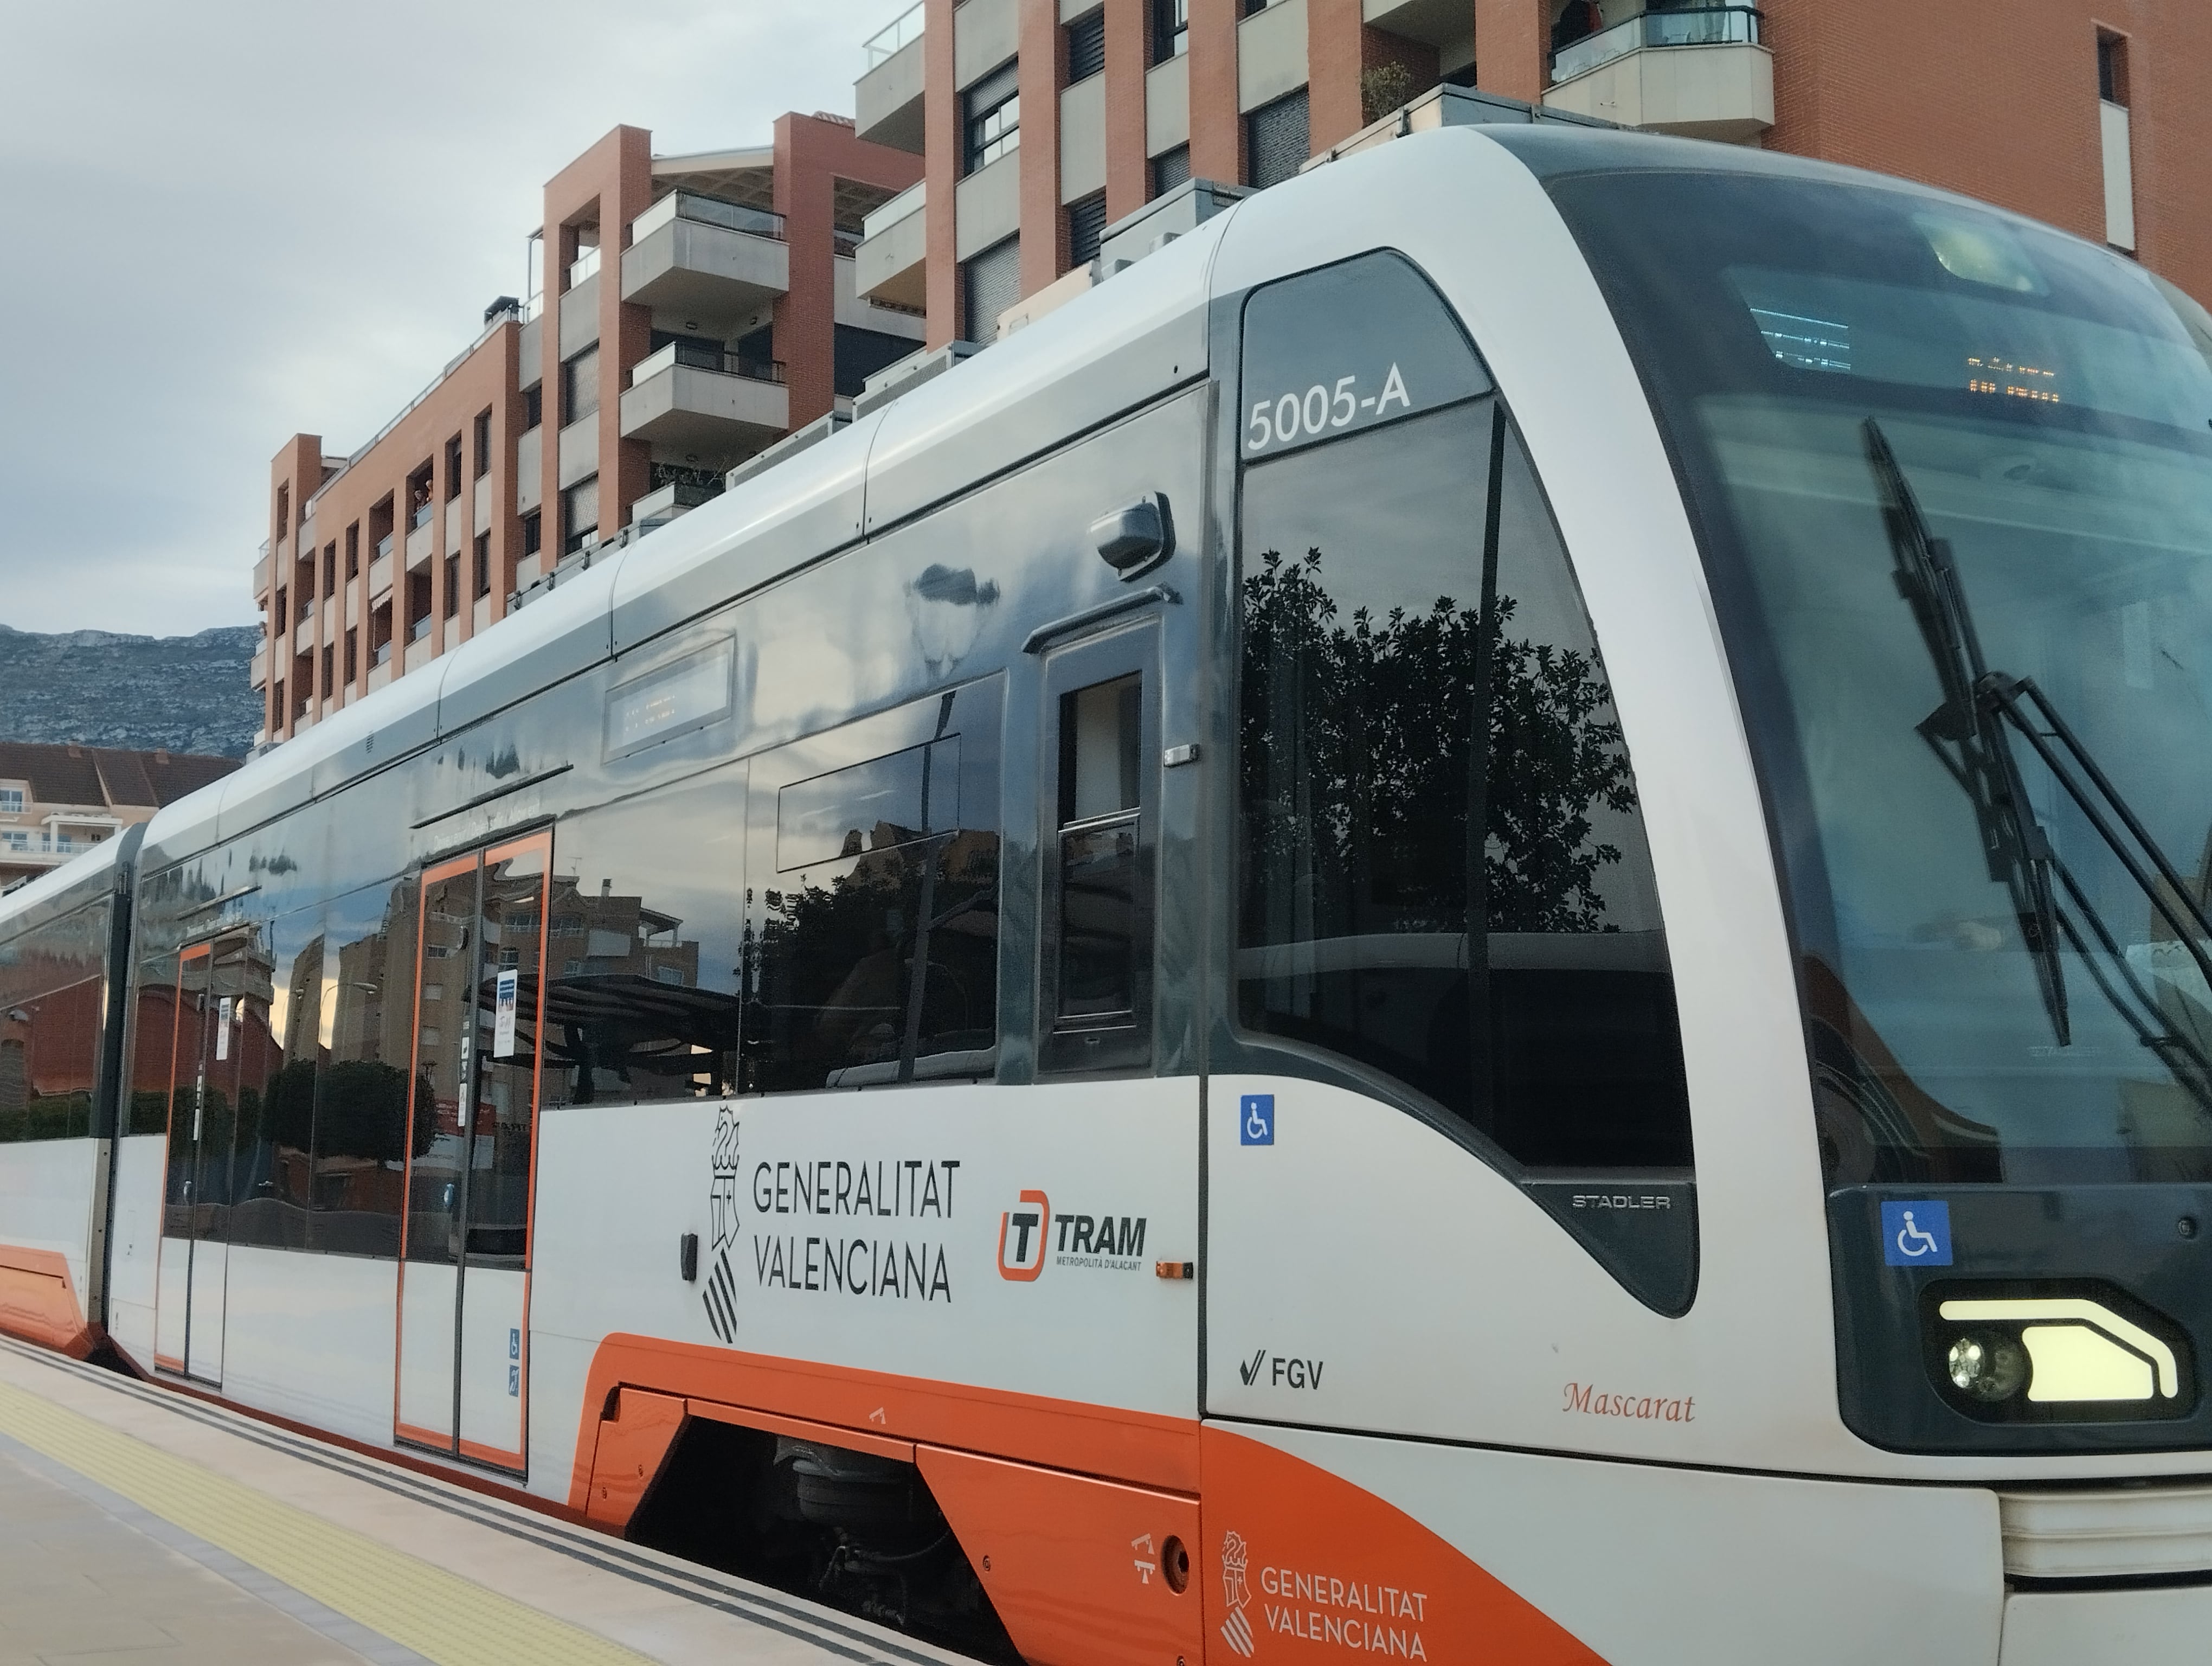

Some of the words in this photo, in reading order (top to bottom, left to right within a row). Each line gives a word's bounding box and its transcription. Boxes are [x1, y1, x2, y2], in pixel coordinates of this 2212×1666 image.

[1248, 362, 1411, 450] 5005-A
[754, 1161, 960, 1219] GENERALITAT
[1572, 1195, 1670, 1209] STADLER
[1055, 1214, 1147, 1257] TRAM
[754, 1235, 951, 1303] VALENCIANA
[1057, 1255, 1102, 1268] METROPOLITÀ
[1104, 1259, 1142, 1271] D'ALACANT
[1272, 1358, 1323, 1390] FGV
[1562, 1382, 1696, 1423] Mascarat
[1261, 1567, 1427, 1623] GENERALITAT
[1264, 1604, 1427, 1662] VALENCIANA
